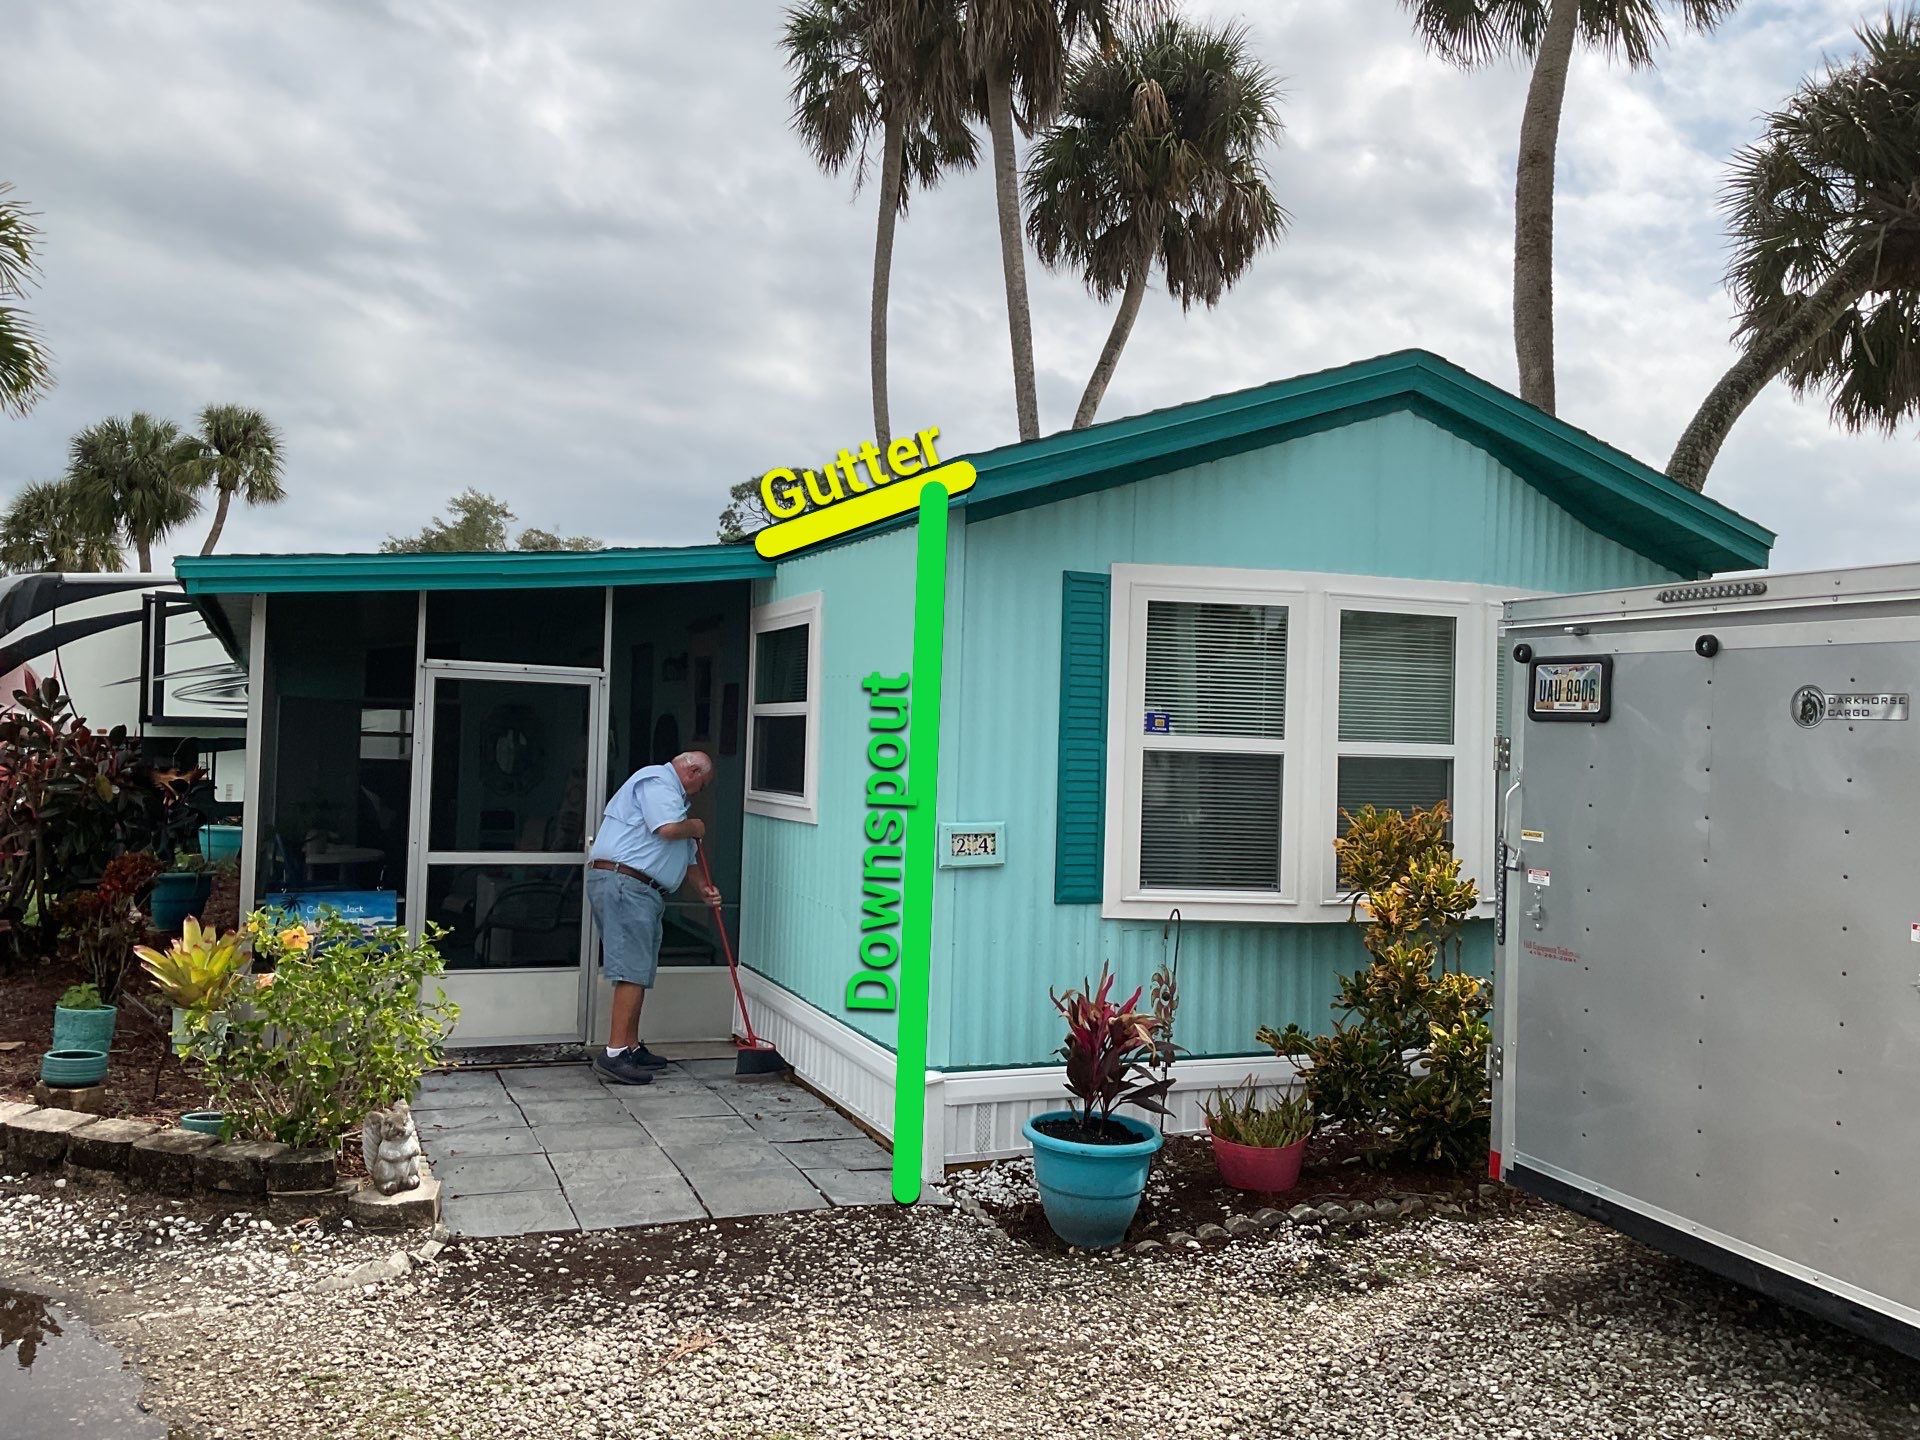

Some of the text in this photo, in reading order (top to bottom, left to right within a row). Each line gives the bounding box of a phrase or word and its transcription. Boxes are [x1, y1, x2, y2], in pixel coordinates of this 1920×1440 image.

[1540, 679, 1596, 702] UAU 8906
[1828, 696, 1906, 705] DARKHORSE
[1827, 709, 1870, 717] CARGO
[956, 837, 989, 853] 24
[342, 904, 364, 913] Jack
